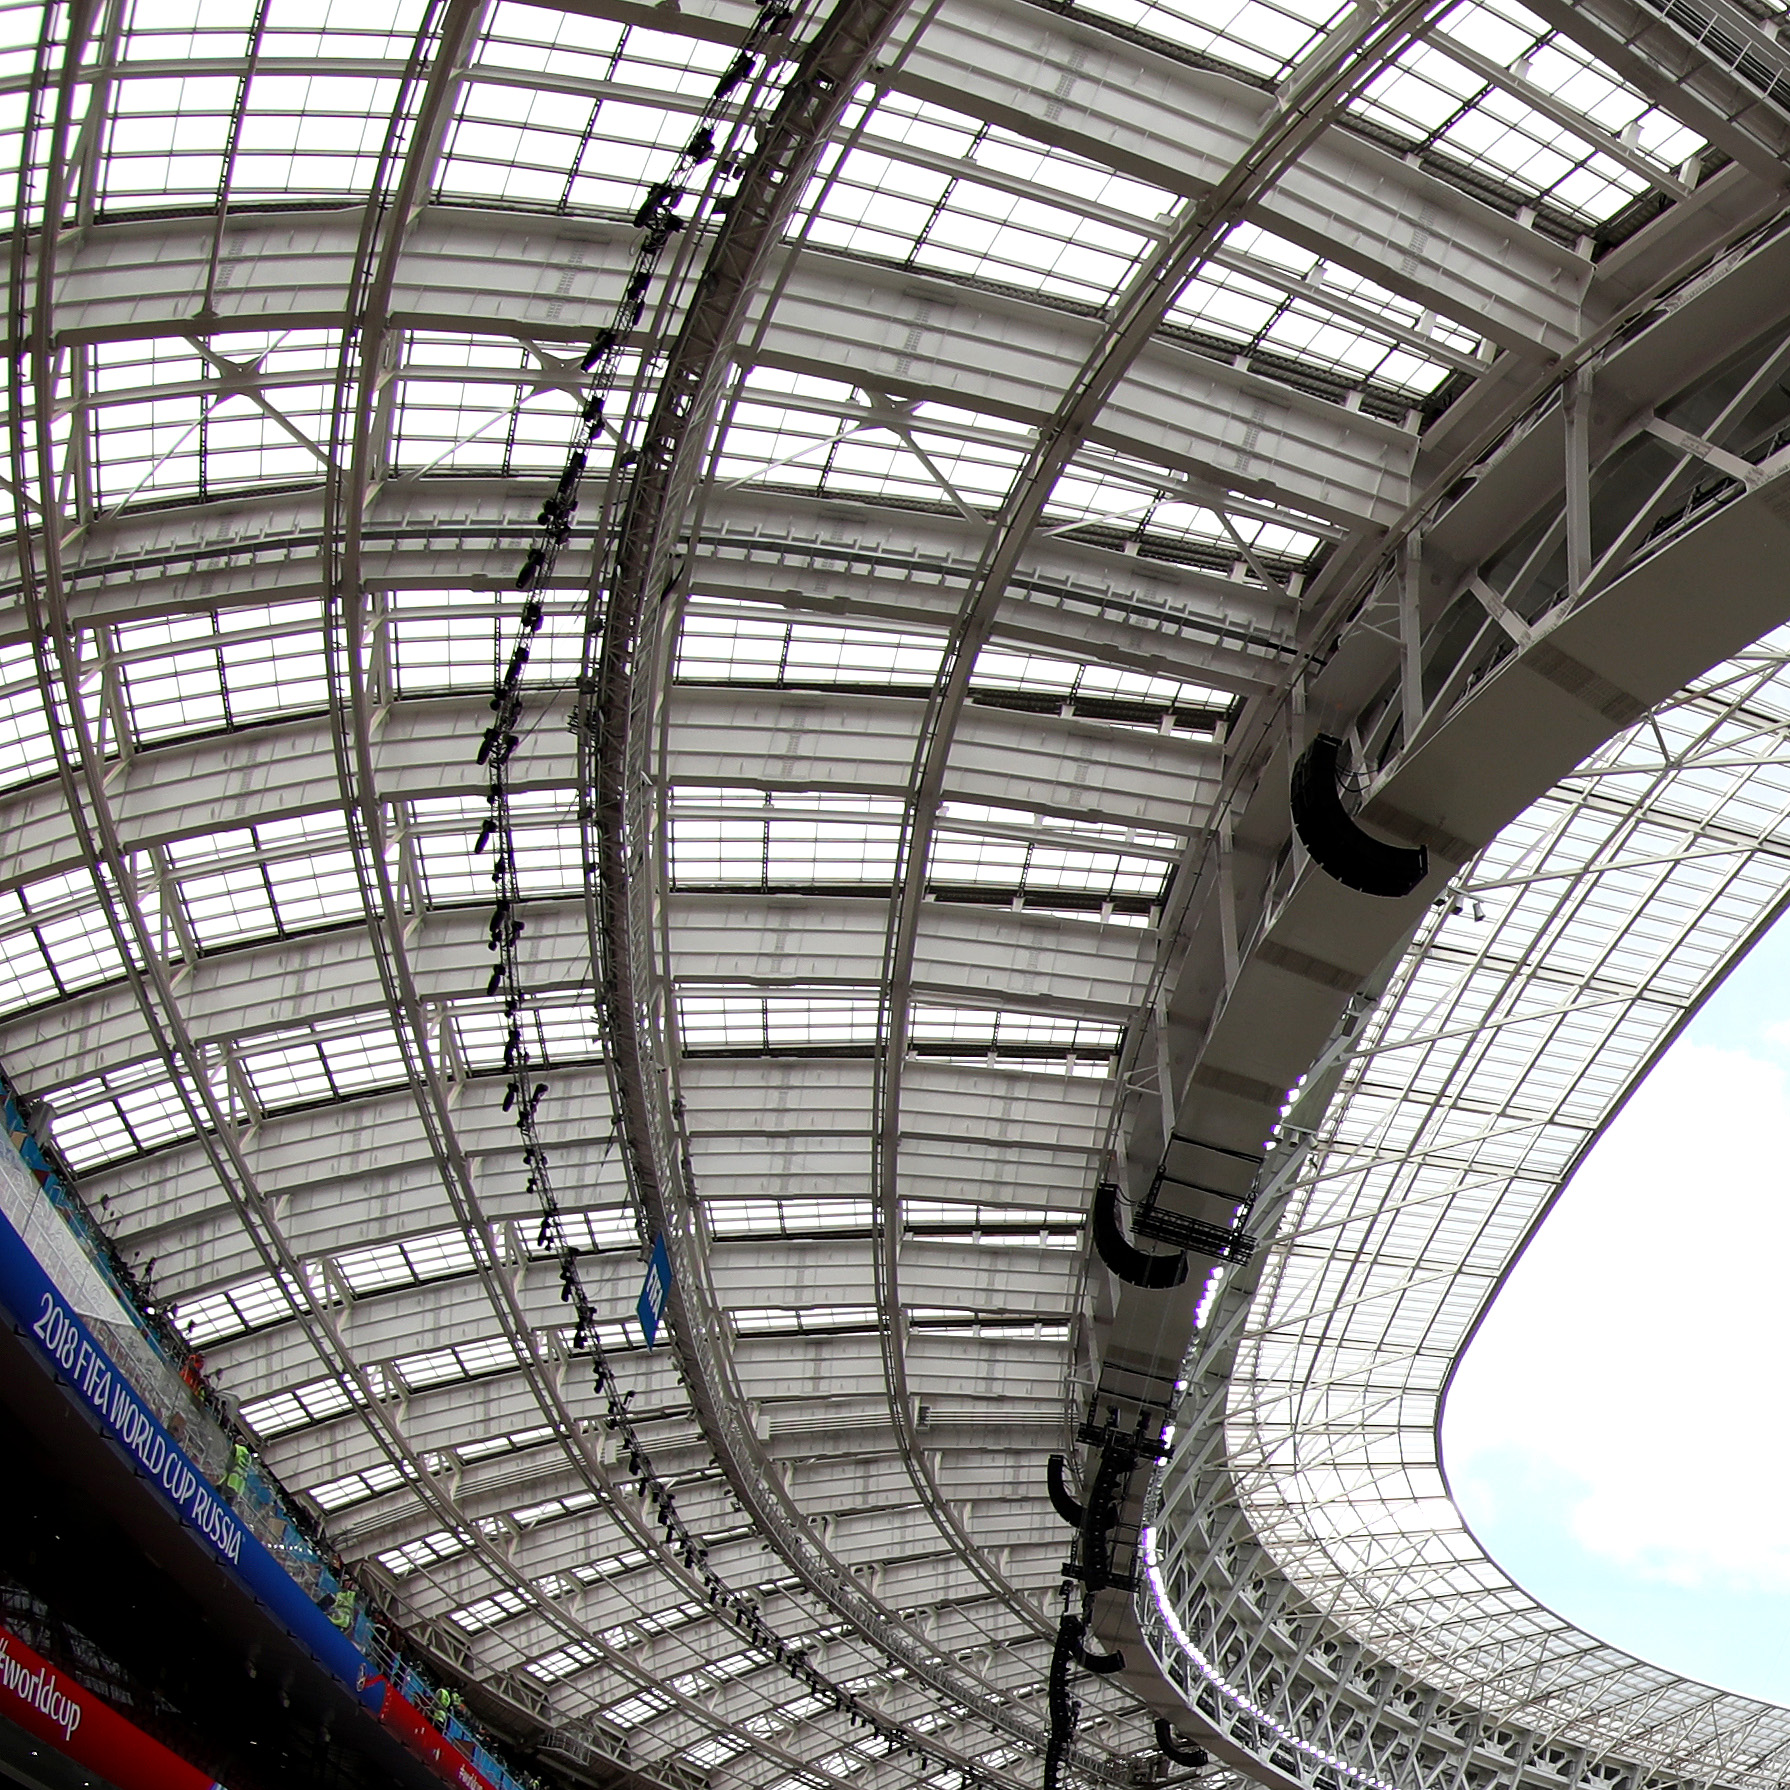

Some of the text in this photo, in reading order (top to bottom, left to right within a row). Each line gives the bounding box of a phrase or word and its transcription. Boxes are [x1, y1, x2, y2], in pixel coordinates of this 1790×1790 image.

[33, 1292, 242, 1565] 2018 FIFA WORLD CUP RUSSIA
